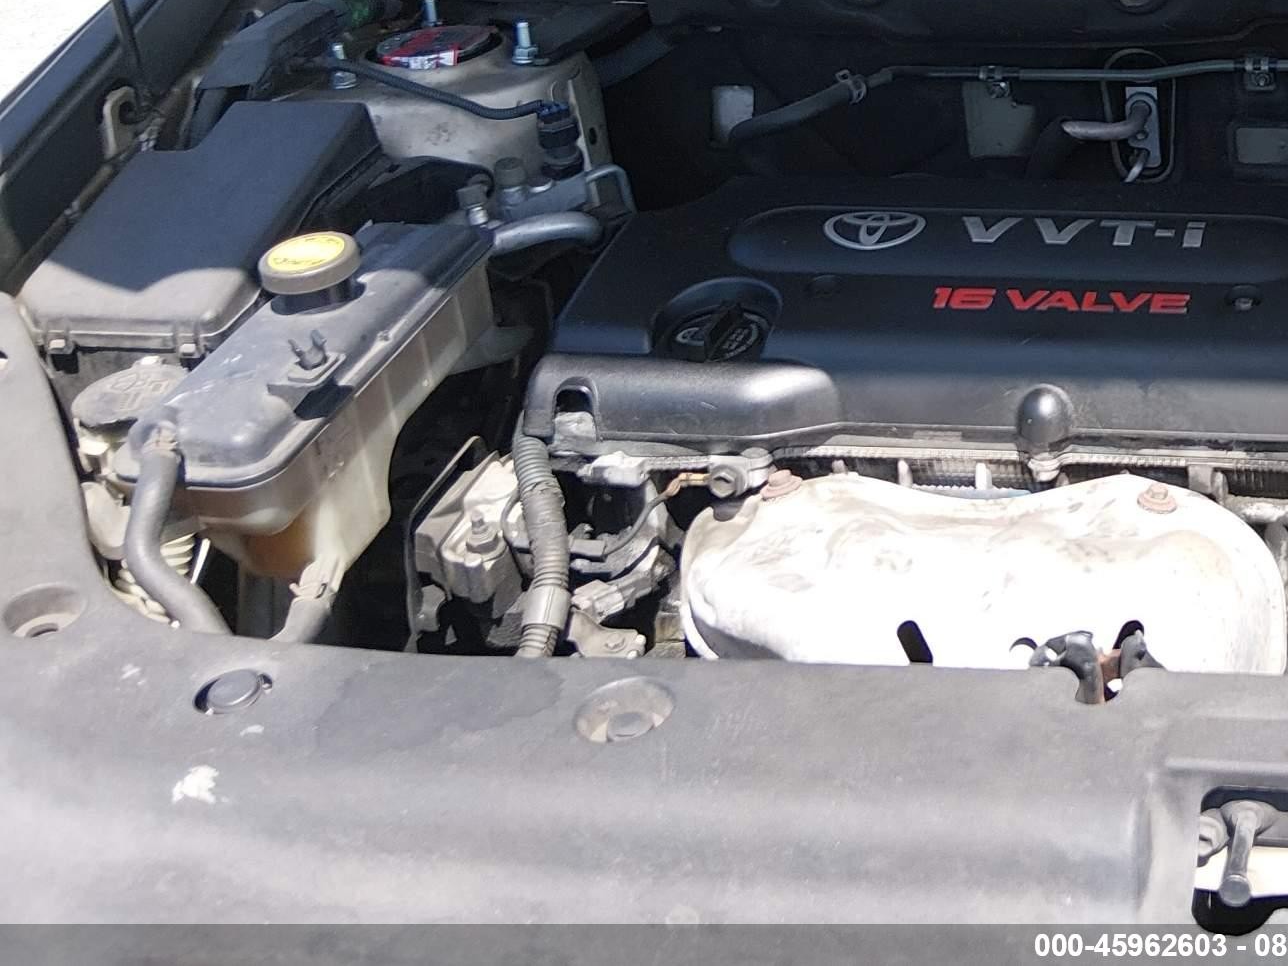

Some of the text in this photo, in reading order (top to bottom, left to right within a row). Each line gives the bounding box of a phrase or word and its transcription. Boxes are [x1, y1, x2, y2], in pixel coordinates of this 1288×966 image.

[963, 216, 1207, 248] VVT-i
[934, 286, 1191, 314] 16 VALVE
